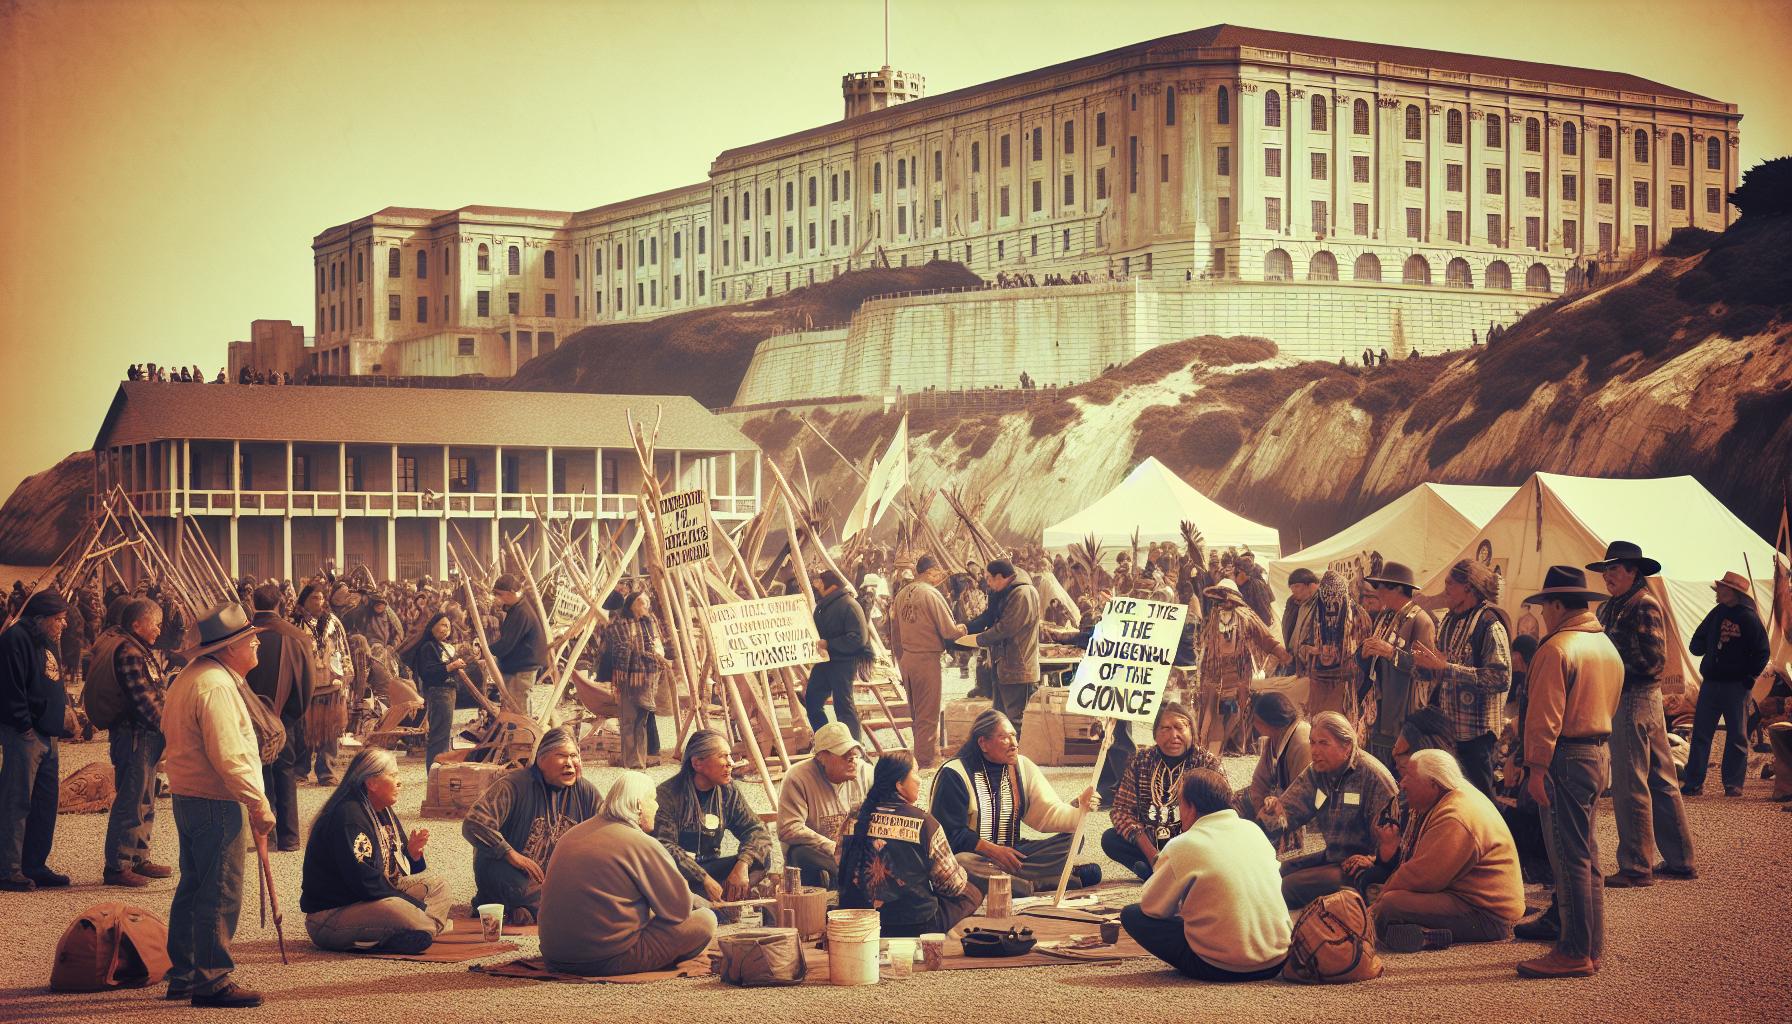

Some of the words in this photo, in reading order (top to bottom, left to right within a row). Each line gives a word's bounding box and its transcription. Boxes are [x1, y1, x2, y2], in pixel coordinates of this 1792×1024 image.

[1120, 620, 1154, 639] THE
[1099, 663, 1124, 680] OF
[1126, 666, 1153, 684] THE
